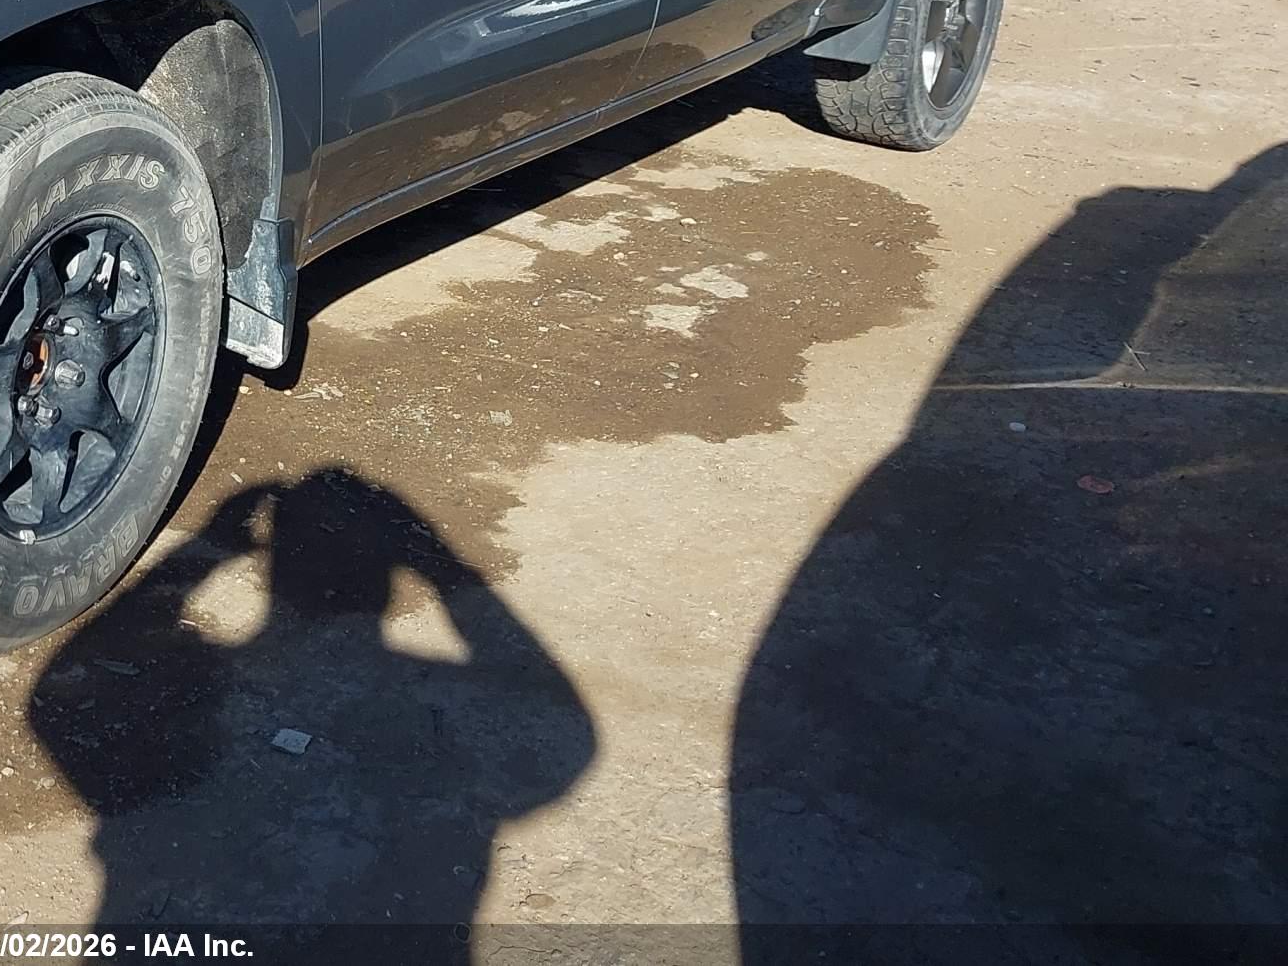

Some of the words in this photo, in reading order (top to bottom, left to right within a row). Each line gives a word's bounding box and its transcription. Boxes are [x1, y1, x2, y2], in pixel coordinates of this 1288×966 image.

[12, 154, 165, 256] MAXXIS
[169, 185, 212, 274] 750
[170, 420, 192, 460] USE
[14, 514, 139, 617] BRAVO
